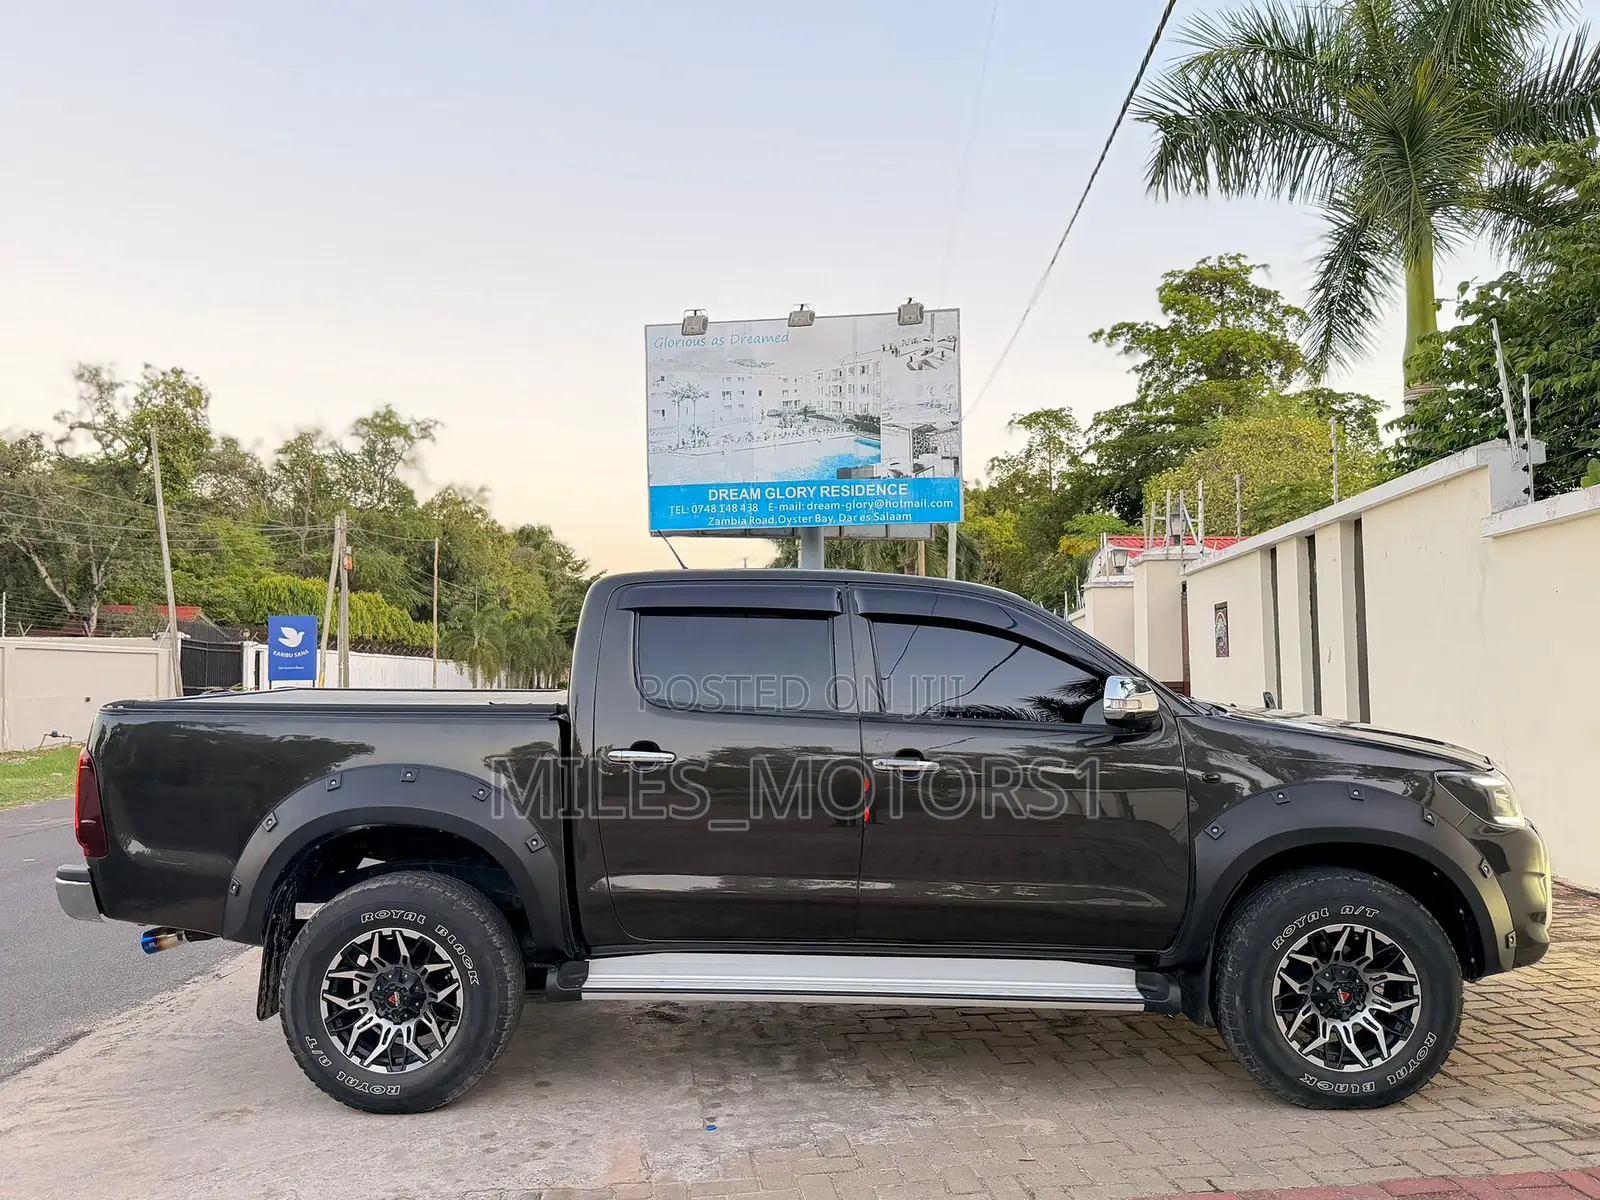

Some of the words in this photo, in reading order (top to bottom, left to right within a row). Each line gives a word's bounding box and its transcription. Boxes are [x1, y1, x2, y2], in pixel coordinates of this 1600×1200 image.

[654, 332, 706, 349] Glorious
[711, 337, 724, 346] as
[730, 331, 790, 345] Dreamed
[708, 488, 761, 501] DREAM
[765, 486, 816, 499] GLORY
[820, 483, 908, 498] RESIDENCE
[669, 505, 689, 515] TEL:
[691, 504, 716, 514] 0748
[719, 503, 738, 513] 148
[740, 502, 758, 512] 438
[768, 501, 804, 511] E-mail:
[806, 499, 954, 511] dream-glory@hotmail.com
[708, 516, 747, 526] Zambia
[815, 513, 836, 524] Bay,
[838, 513, 857, 522] Dar
[859, 514, 871, 522] es
[873, 512, 912, 521] Salaam
[272, 650, 293, 659] KARIBU
[294, 649, 309, 658] SANA
[1272, 907, 1330, 950] ROYAL
[1341, 905, 1380, 918] A/T
[361, 909, 427, 924] ROYAL
[435, 925, 480, 985] BLACK
[1387, 1032, 1437, 1086] ROYAL
[336, 1071, 401, 1096] ROYAL
[1299, 1072, 1376, 1093] BLACK
